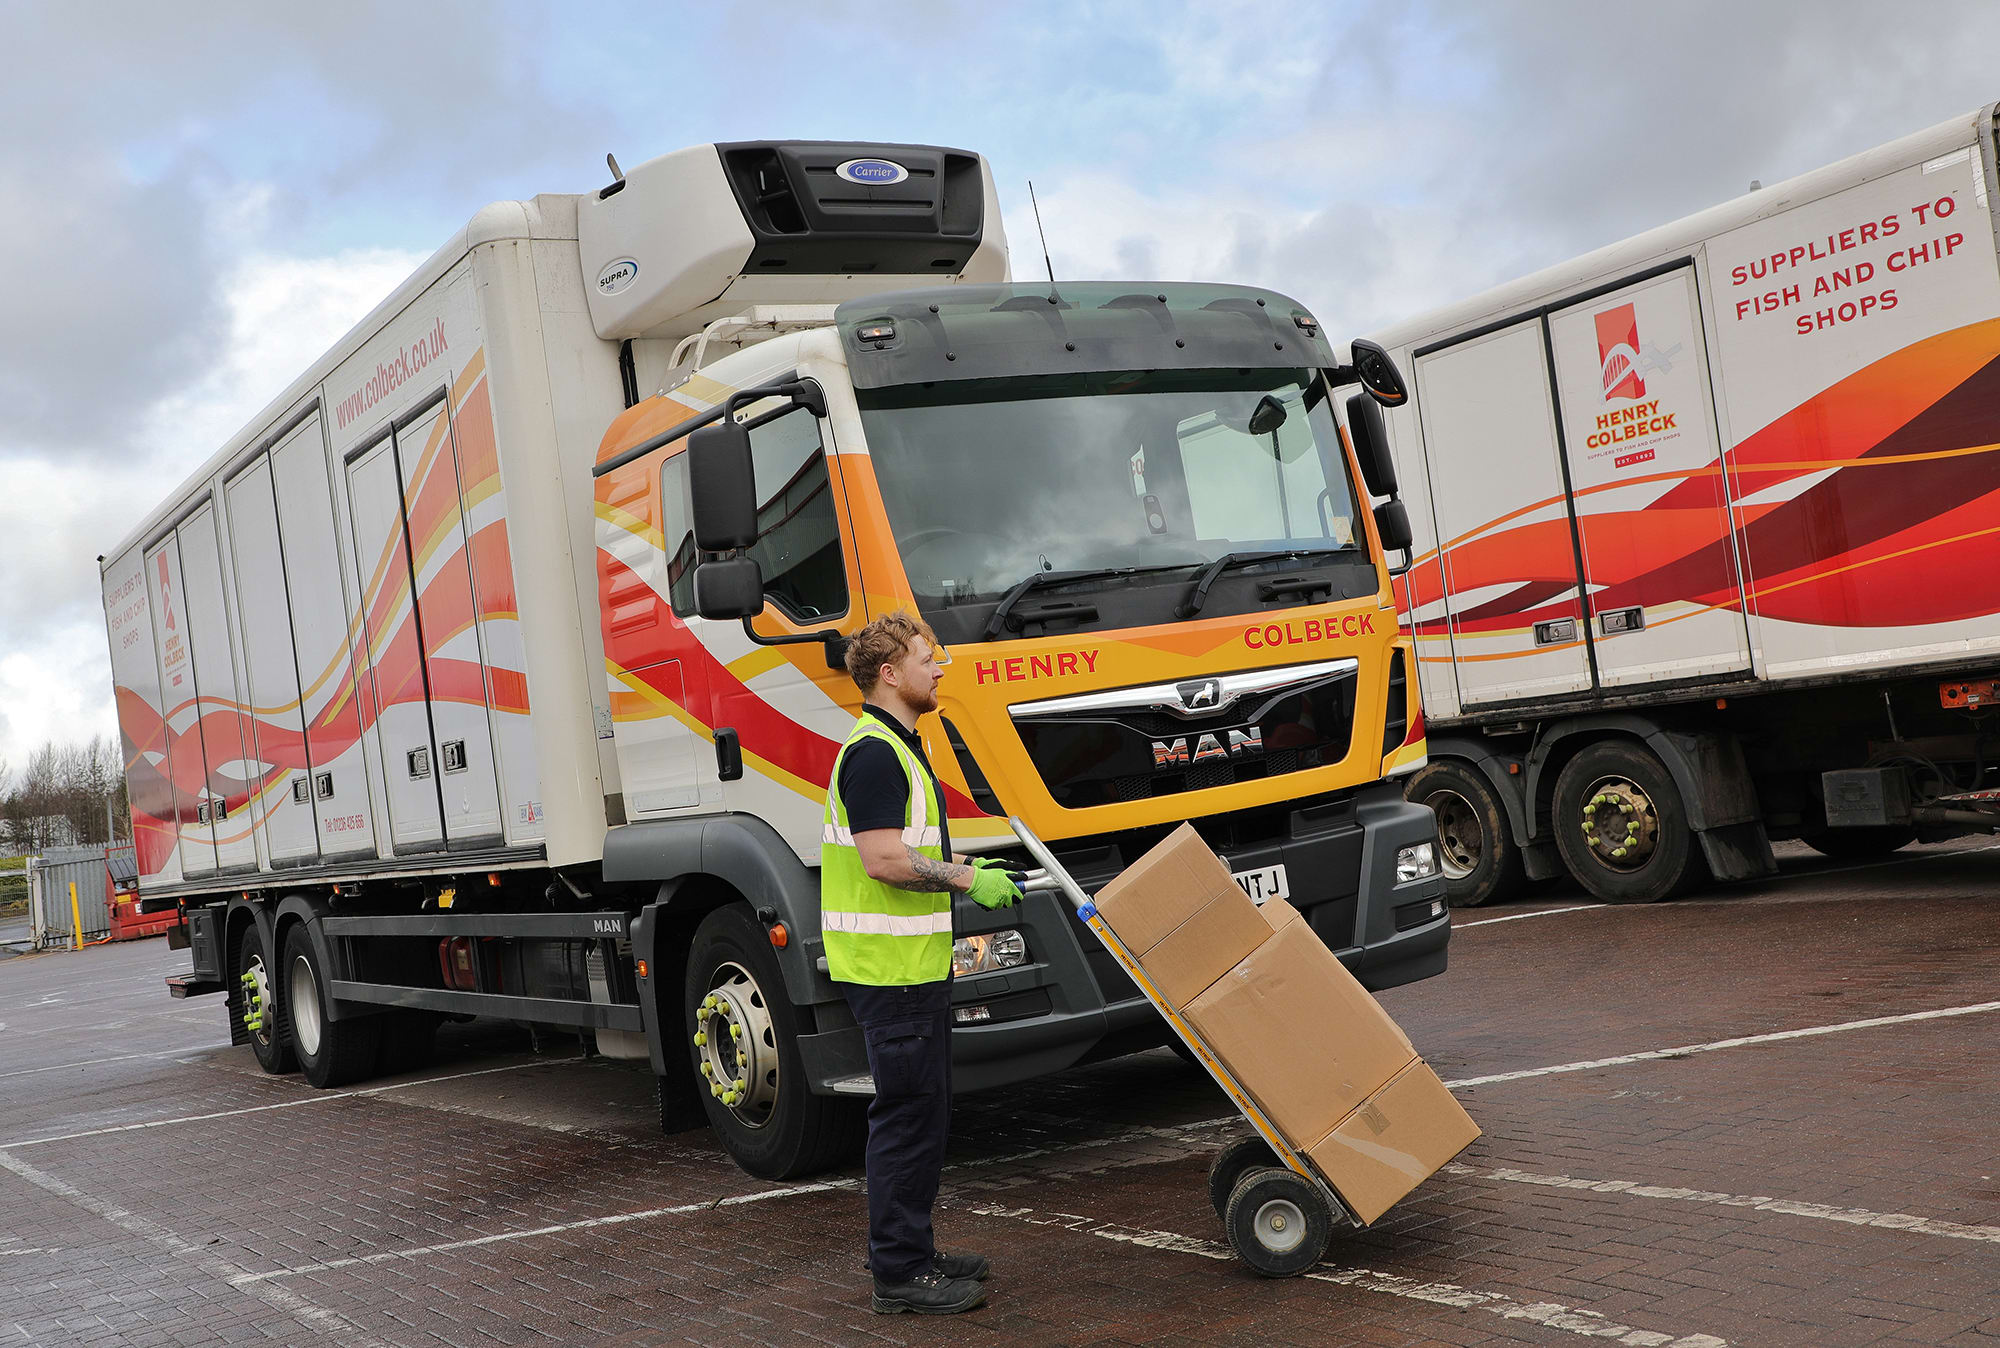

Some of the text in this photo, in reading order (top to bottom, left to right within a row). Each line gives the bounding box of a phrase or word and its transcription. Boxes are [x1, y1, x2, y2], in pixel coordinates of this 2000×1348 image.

[855, 166, 892, 177] Carrier
[1731, 197, 1955, 286] SUPPLIERS TO
[600, 268, 628, 287] SUPRA
[1735, 233, 1964, 321] FISH AND CHIP
[1796, 289, 1898, 335] SHOPS
[336, 317, 448, 430] www.colbeck.co.uk
[1586, 413, 1677, 449] COLBECK
[1596, 400, 1660, 430] HENRY
[1588, 449, 1615, 460] SUPPLIERS
[1663, 433, 1680, 441] SHOPS
[1244, 613, 1376, 650] COLBECK
[975, 649, 1100, 686] HENRY
[1151, 726, 1264, 769] MAN
[593, 919, 621, 932] MAN
